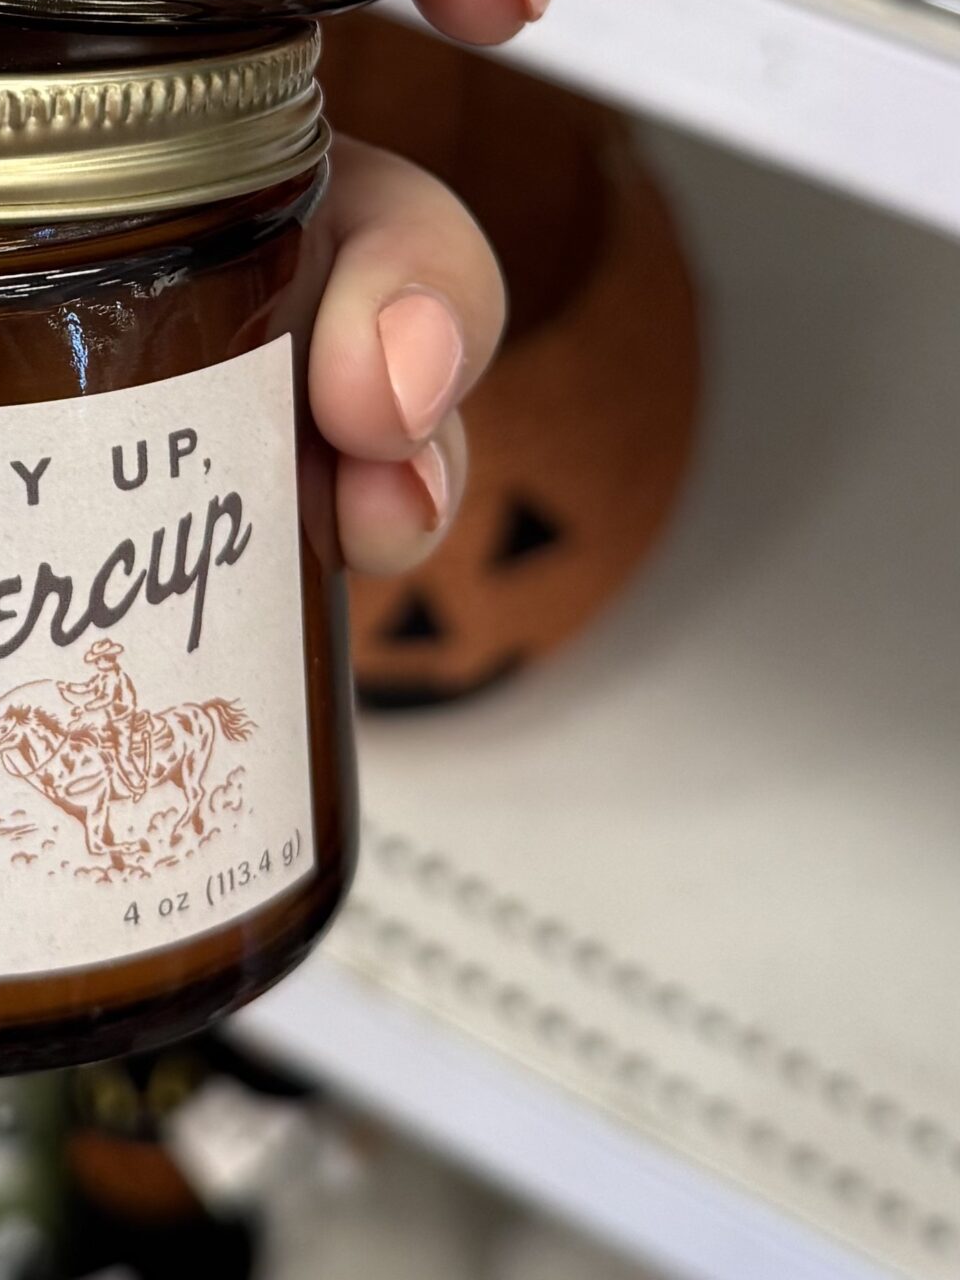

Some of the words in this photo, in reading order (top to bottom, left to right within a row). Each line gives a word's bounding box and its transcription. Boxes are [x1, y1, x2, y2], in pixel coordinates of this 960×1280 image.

[112, 428, 211, 491] UP,
[124, 901, 140, 925] 4
[158, 892, 190, 917] oz
[205, 849, 271, 906] (113.4
[282, 829, 302, 870] g)
